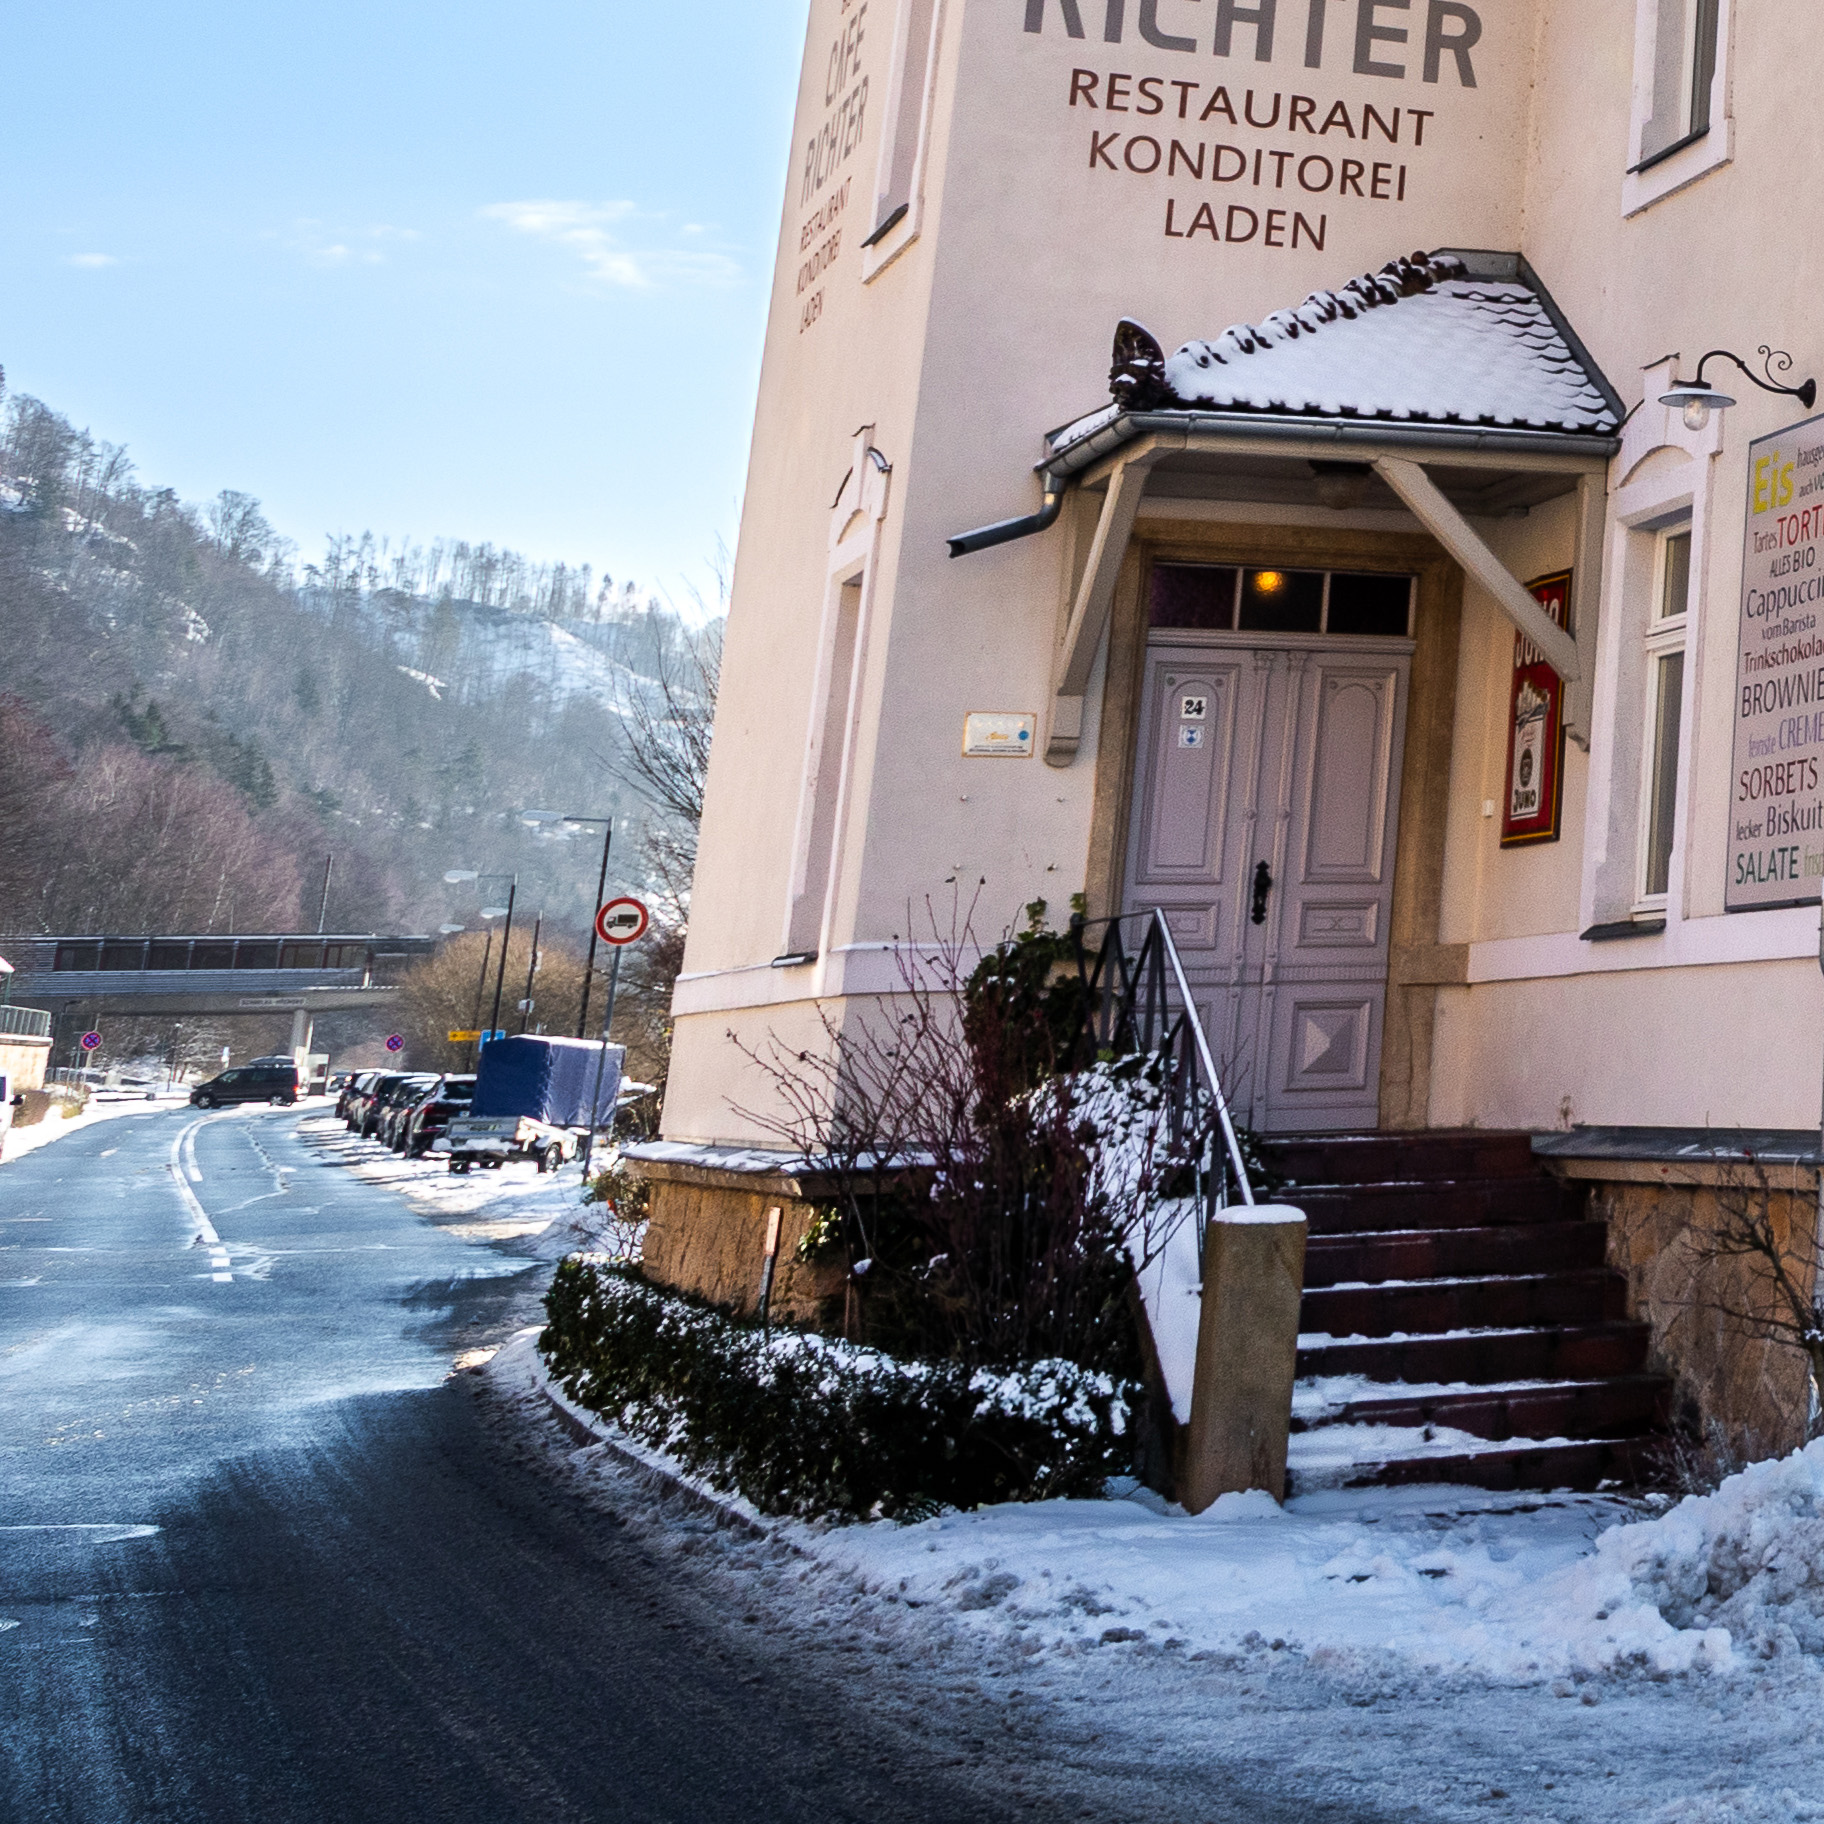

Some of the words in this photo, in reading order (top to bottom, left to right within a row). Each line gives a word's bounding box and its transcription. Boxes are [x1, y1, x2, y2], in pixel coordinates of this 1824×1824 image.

[1068, 68, 1435, 147] RESTAURANT
[800, 74, 869, 208] RICHTER
[1088, 130, 1408, 202] KONDITOREI
[800, 176, 852, 254] RESTAURANT
[1163, 198, 1327, 251] LADEN
[1753, 450, 1796, 514] Eis
[1770, 554, 1791, 577] ALLES
[1794, 546, 1815, 572] BIO
[1762, 624, 1782, 640] vom
[1783, 614, 1816, 636] Barista
[1185, 700, 1205, 715] 24
[1739, 757, 1817, 801] SORBETS
[1766, 798, 1824, 837] Biskuit
[1736, 846, 1799, 884] SALATE
